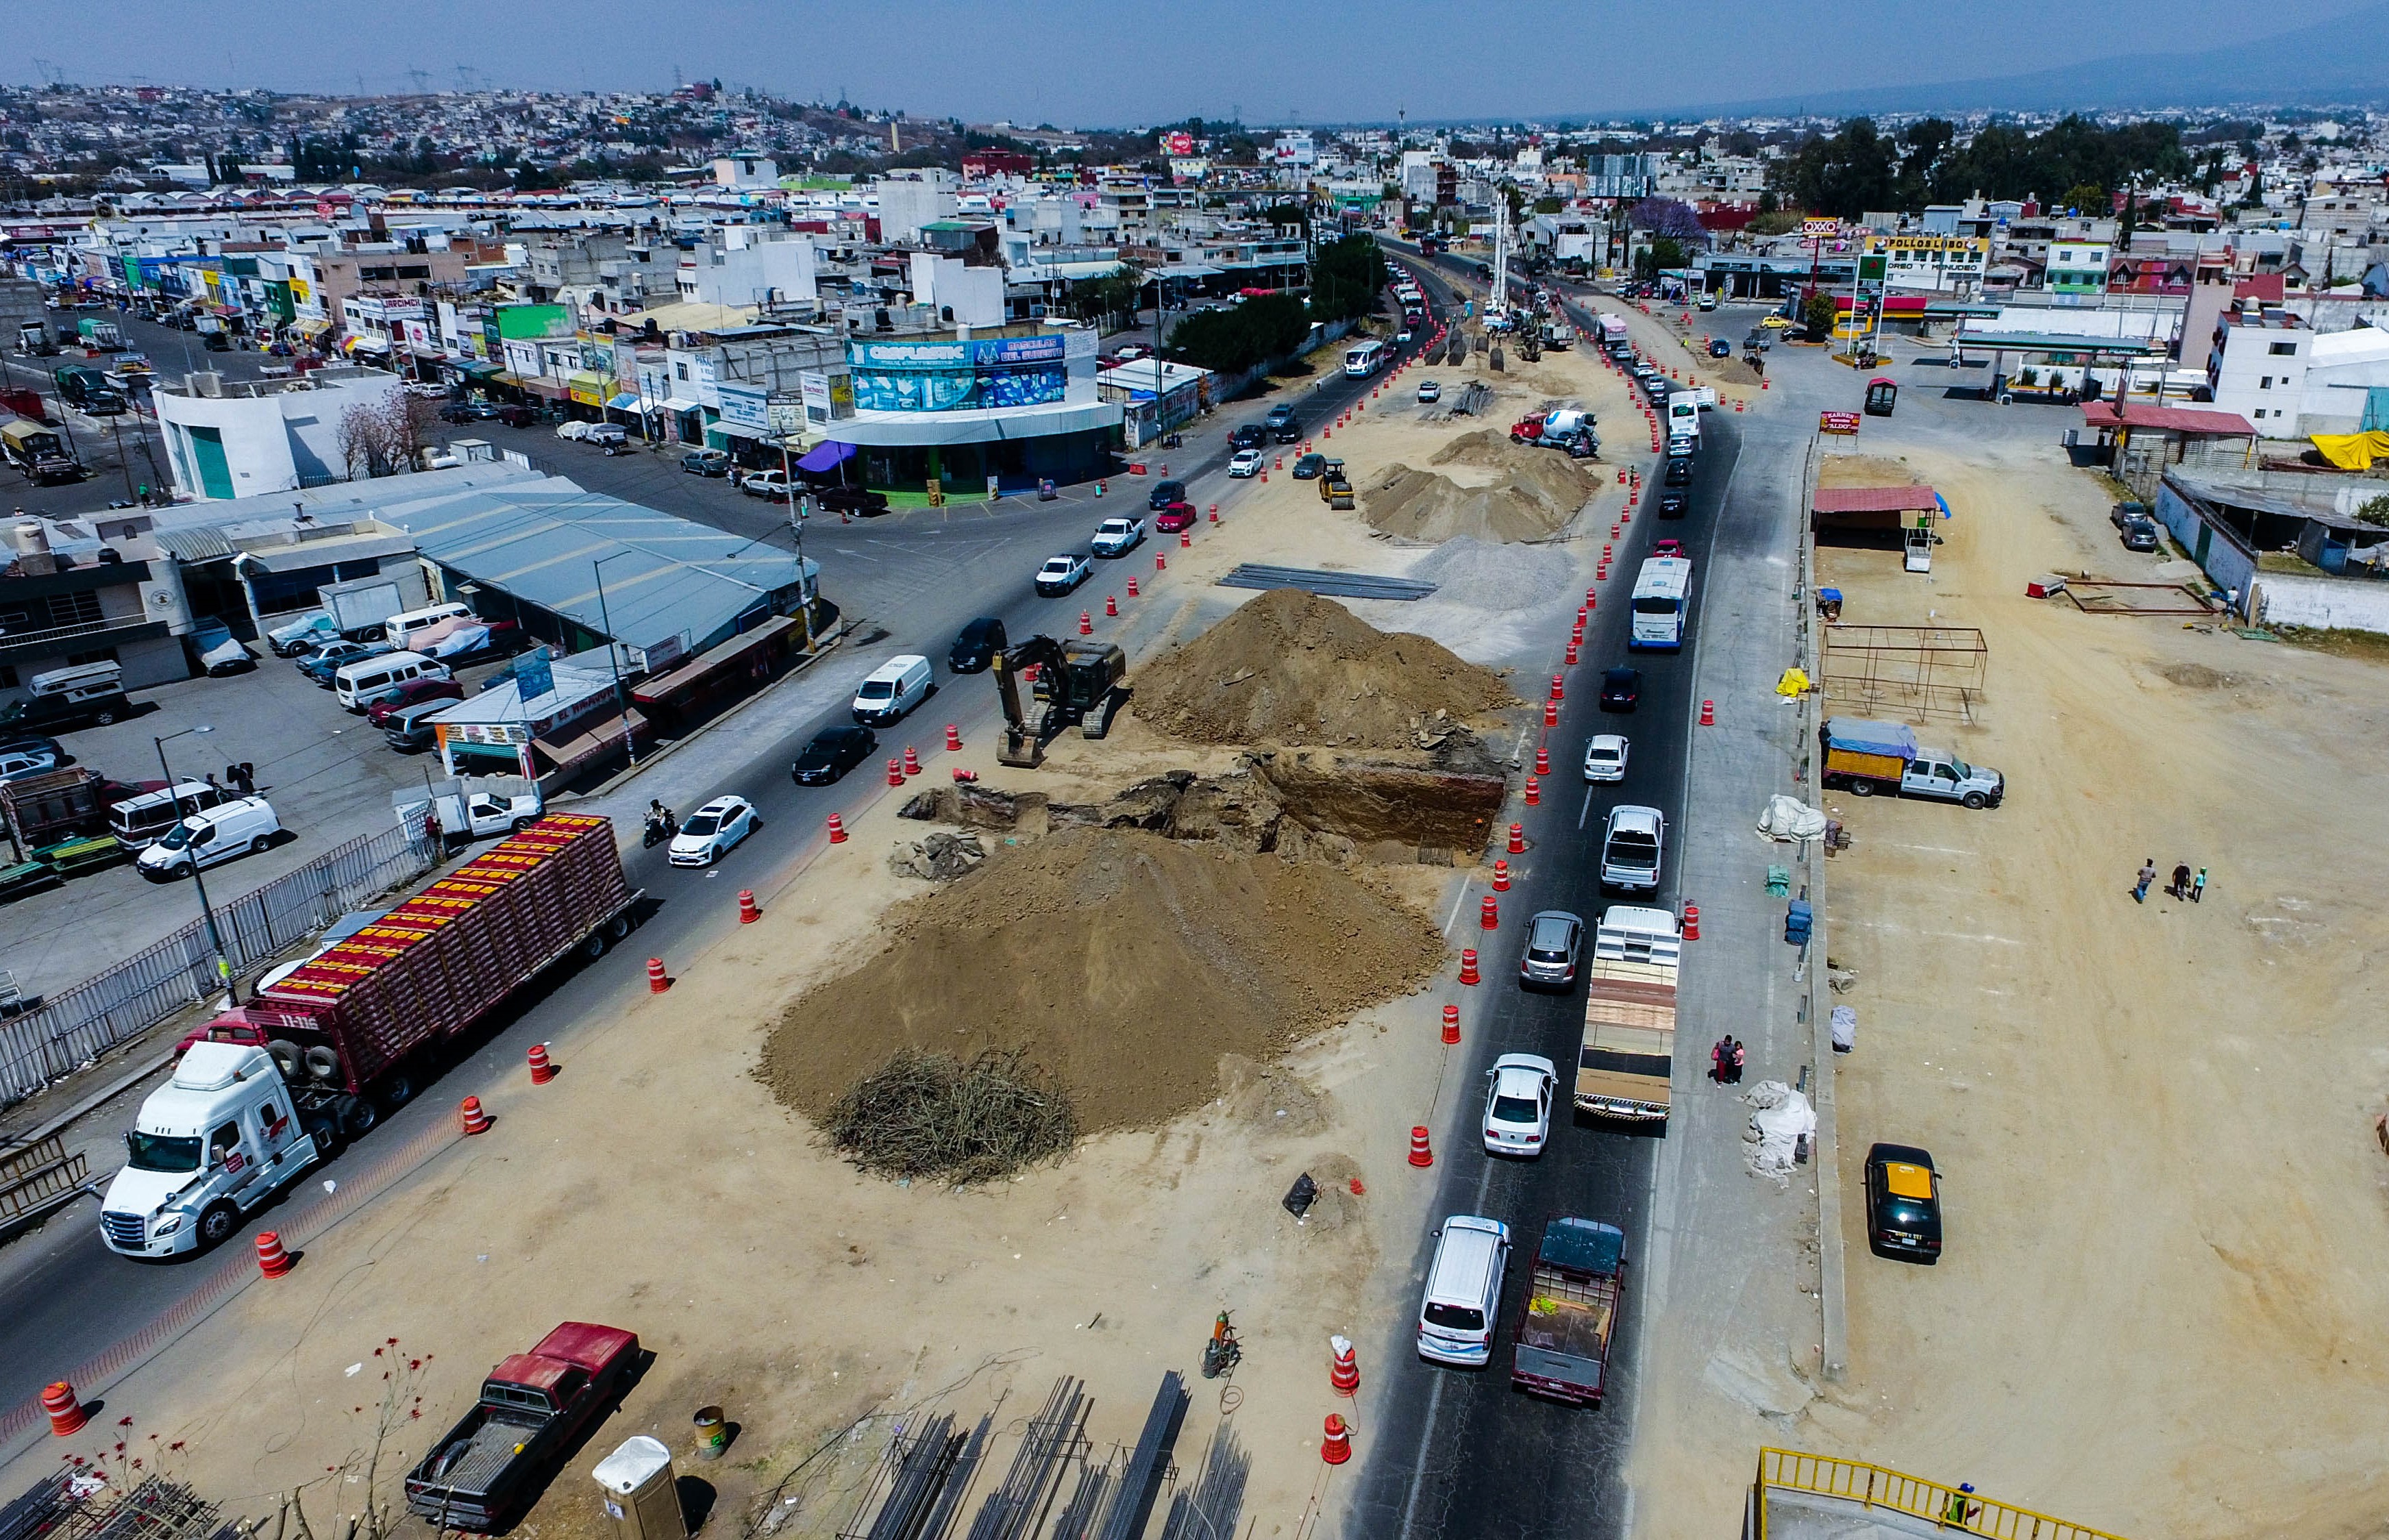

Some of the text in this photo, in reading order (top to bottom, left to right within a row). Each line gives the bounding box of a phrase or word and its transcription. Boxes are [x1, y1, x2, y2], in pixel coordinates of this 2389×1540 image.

[1804, 222, 1836, 232] OXXO
[1890, 239, 1931, 248] POLLOS
[1007, 338, 1056, 351] BASCULAS
[1001, 347, 1063, 362] DEL SURESTE
[279, 1014, 320, 1030] 11-116
